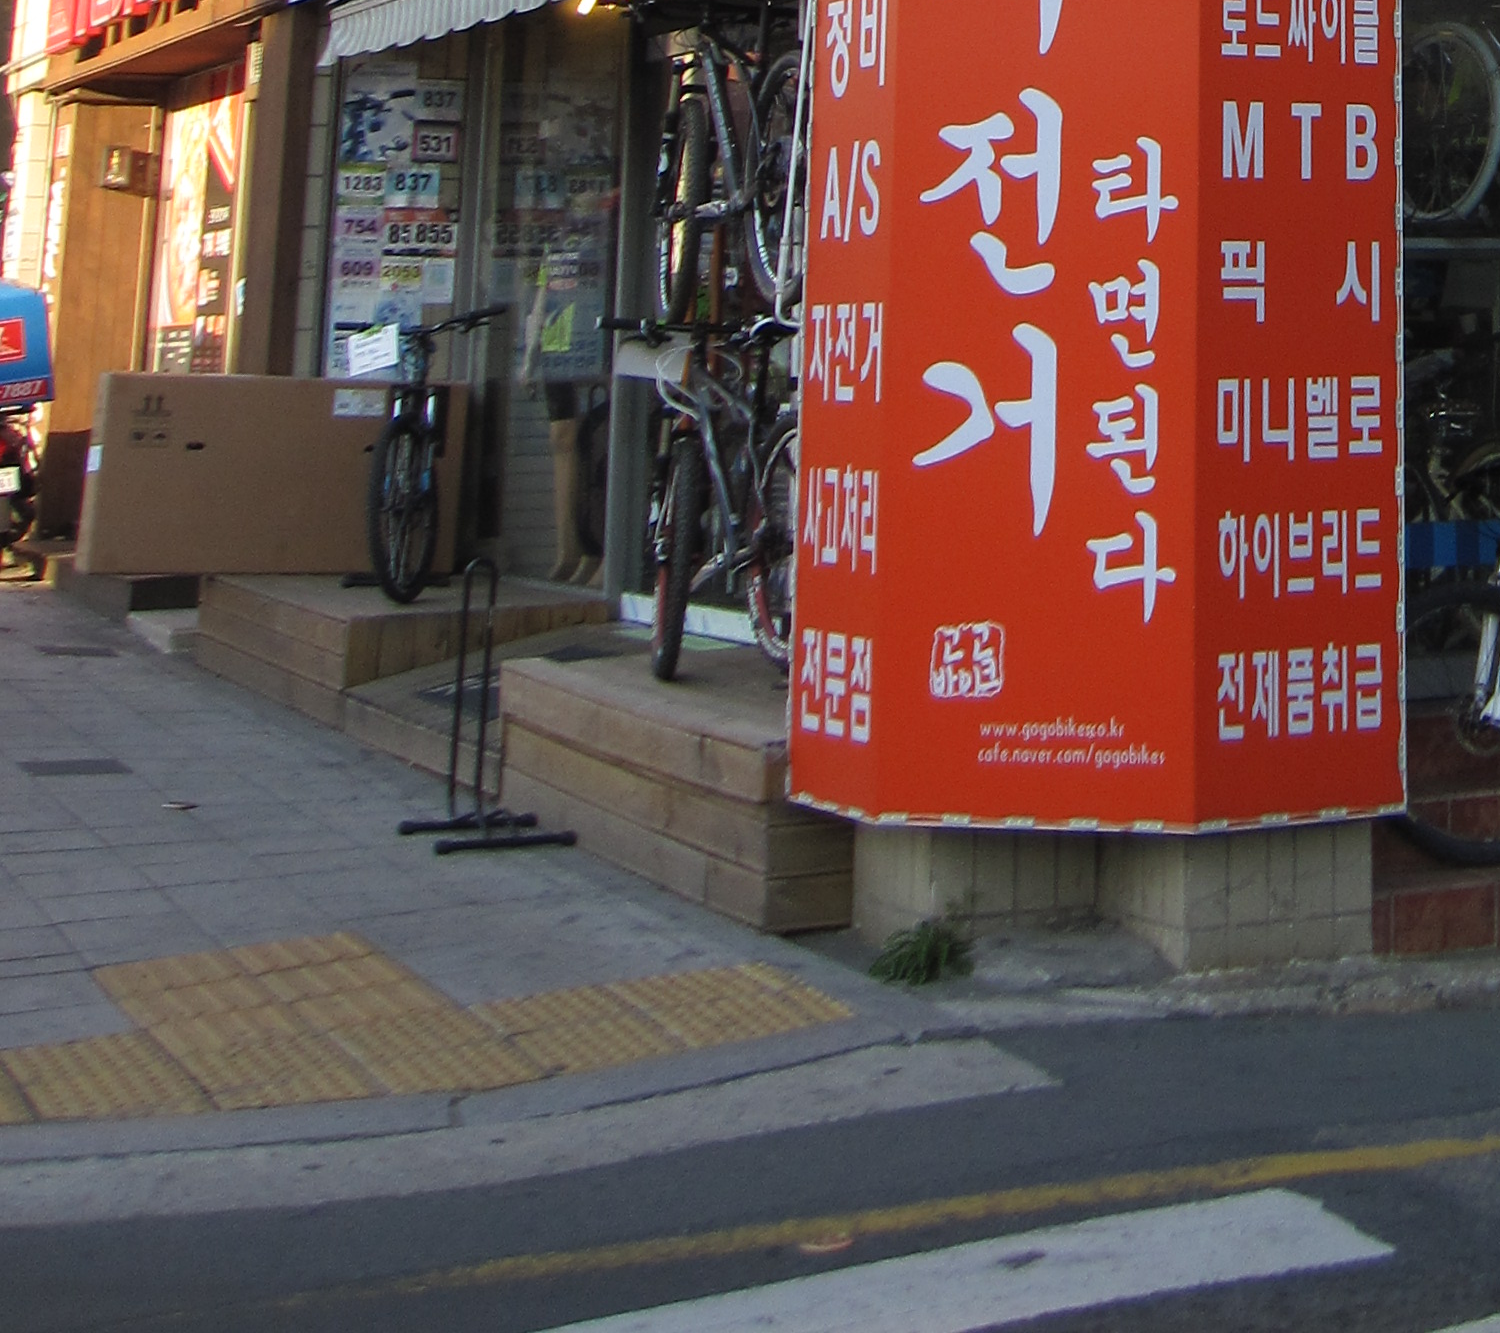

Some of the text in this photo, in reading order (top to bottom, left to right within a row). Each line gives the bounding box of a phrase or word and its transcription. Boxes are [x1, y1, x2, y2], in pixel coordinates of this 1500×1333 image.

[343, 174, 384, 192] 1283
[394, 173, 432, 192] 837
[418, 134, 451, 153] 531
[1221, 99, 1380, 182] MTB
[343, 218, 377, 234] 754
[820, 138, 882, 243] A/S
[809, 300, 884, 405] 자전거
[1217, 374, 1384, 464] 미니벨로
[802, 463, 880, 576] 사고처리
[1217, 506, 1384, 600] 하이브리드
[799, 626, 873, 744] 전문점
[1217, 641, 1384, 743] 전제품취급
